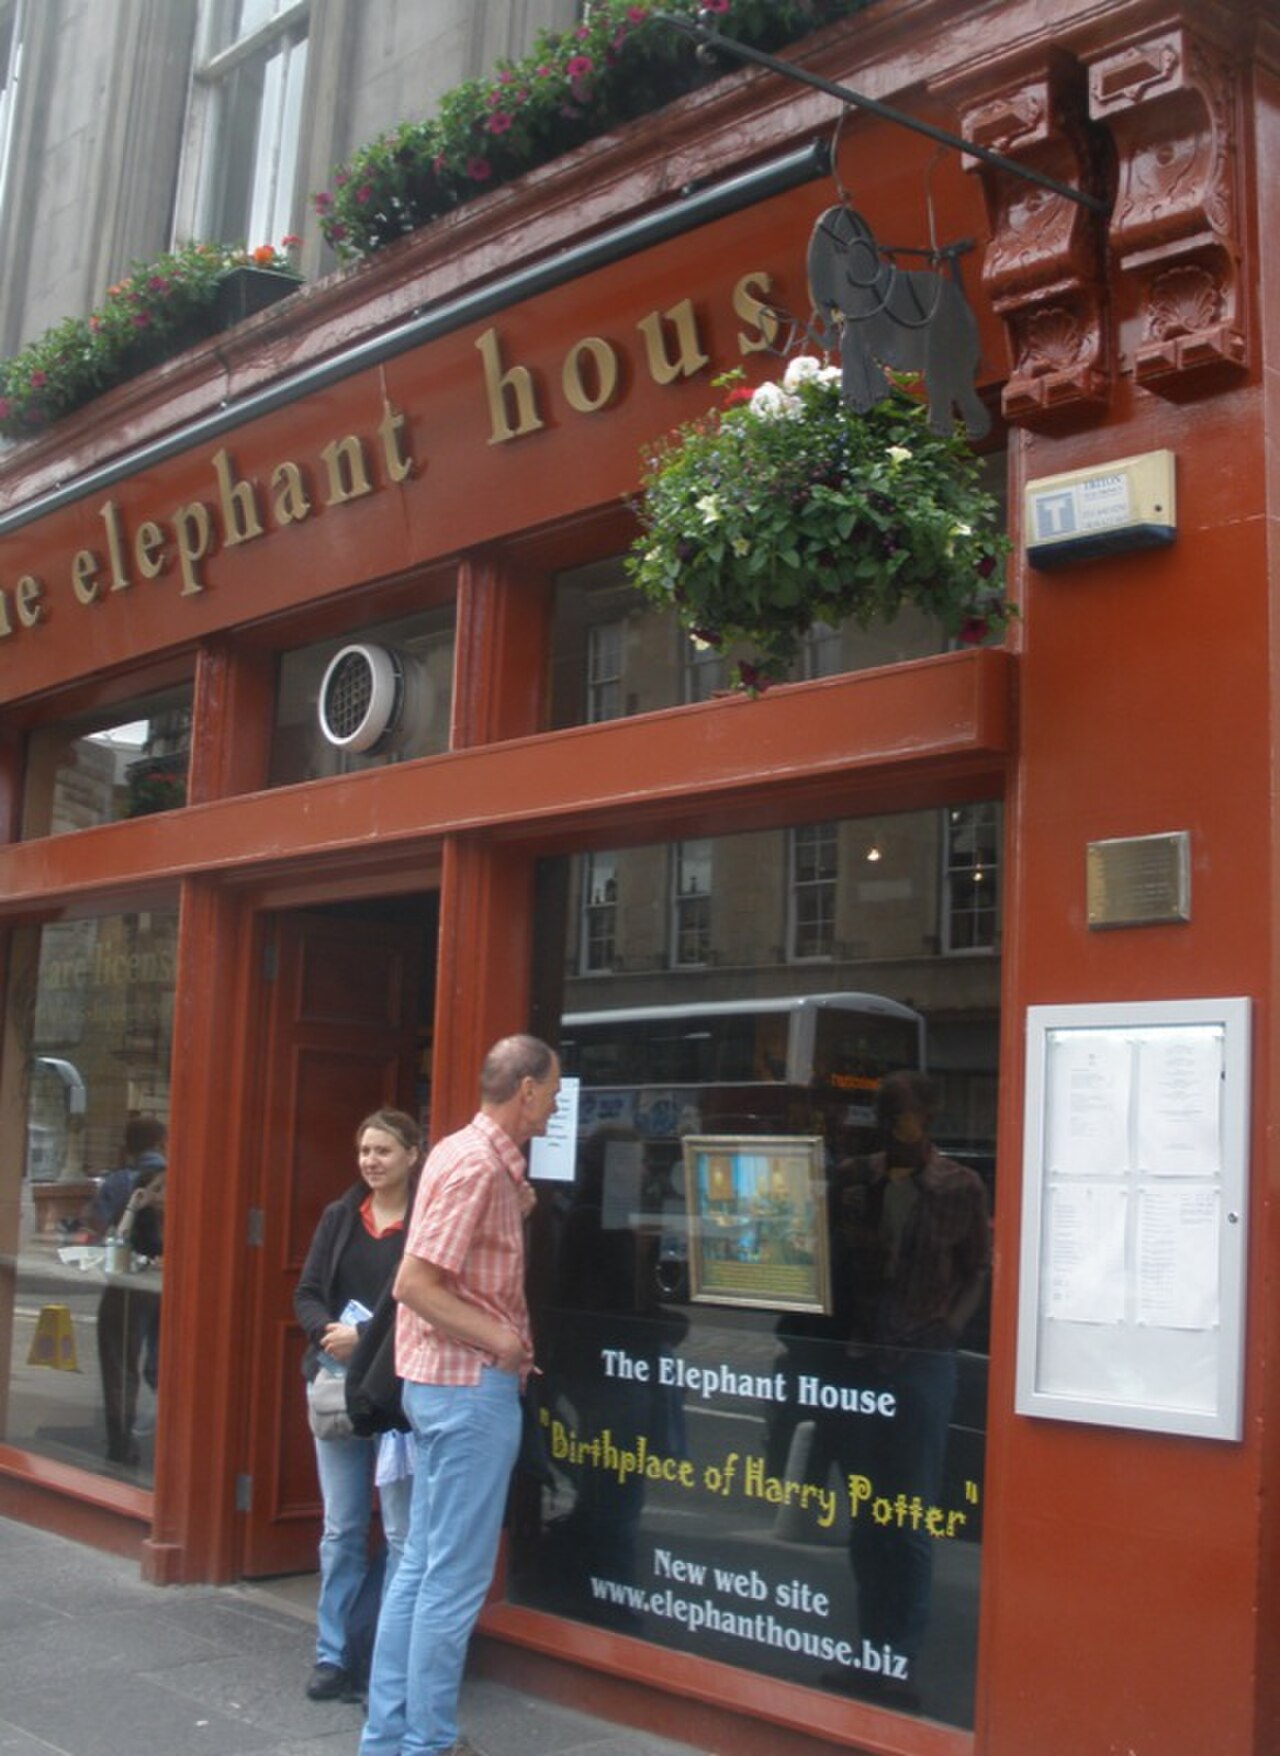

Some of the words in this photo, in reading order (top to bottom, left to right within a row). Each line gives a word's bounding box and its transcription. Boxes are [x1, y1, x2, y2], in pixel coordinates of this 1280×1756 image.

[71, 400, 413, 604] elephant
[475, 272, 780, 446] hous
[602, 1349, 650, 1382] The
[659, 1358, 787, 1402] Elephant
[798, 1375, 897, 1417] House
[705, 1453, 739, 1495] of
[745, 1455, 836, 1527] Harry
[654, 1548, 706, 1586] New
[714, 1567, 768, 1601] web
[776, 1580, 829, 1616] site
[590, 1575, 908, 1680] www.elephanthouse.biz
